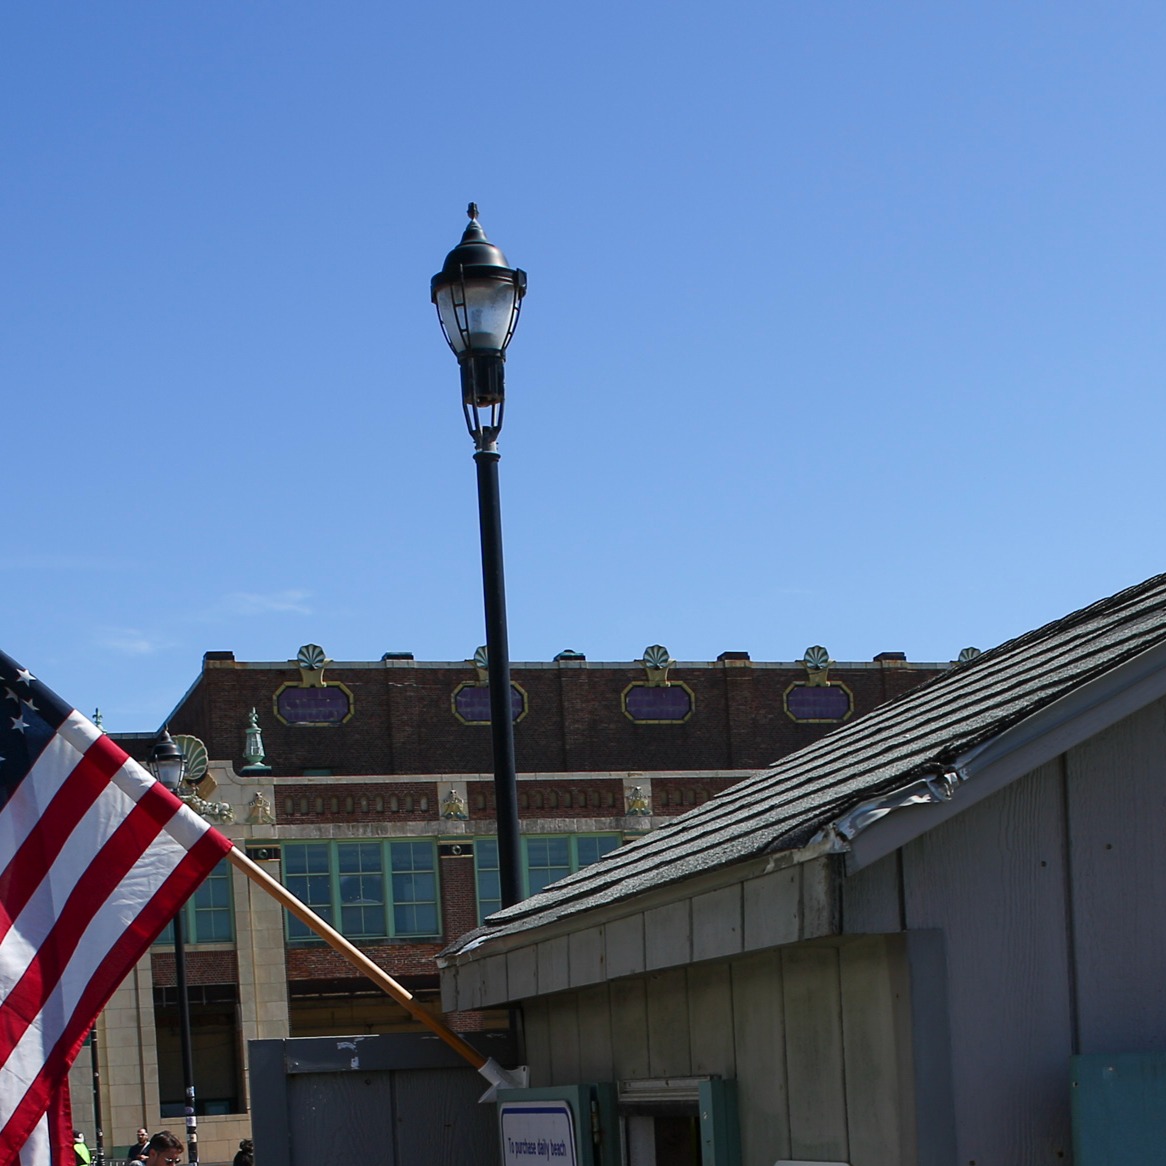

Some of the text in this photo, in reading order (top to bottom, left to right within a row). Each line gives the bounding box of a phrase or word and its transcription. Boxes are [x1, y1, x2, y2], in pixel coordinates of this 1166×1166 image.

[508, 1137, 567, 1161] To purchase daily beach
